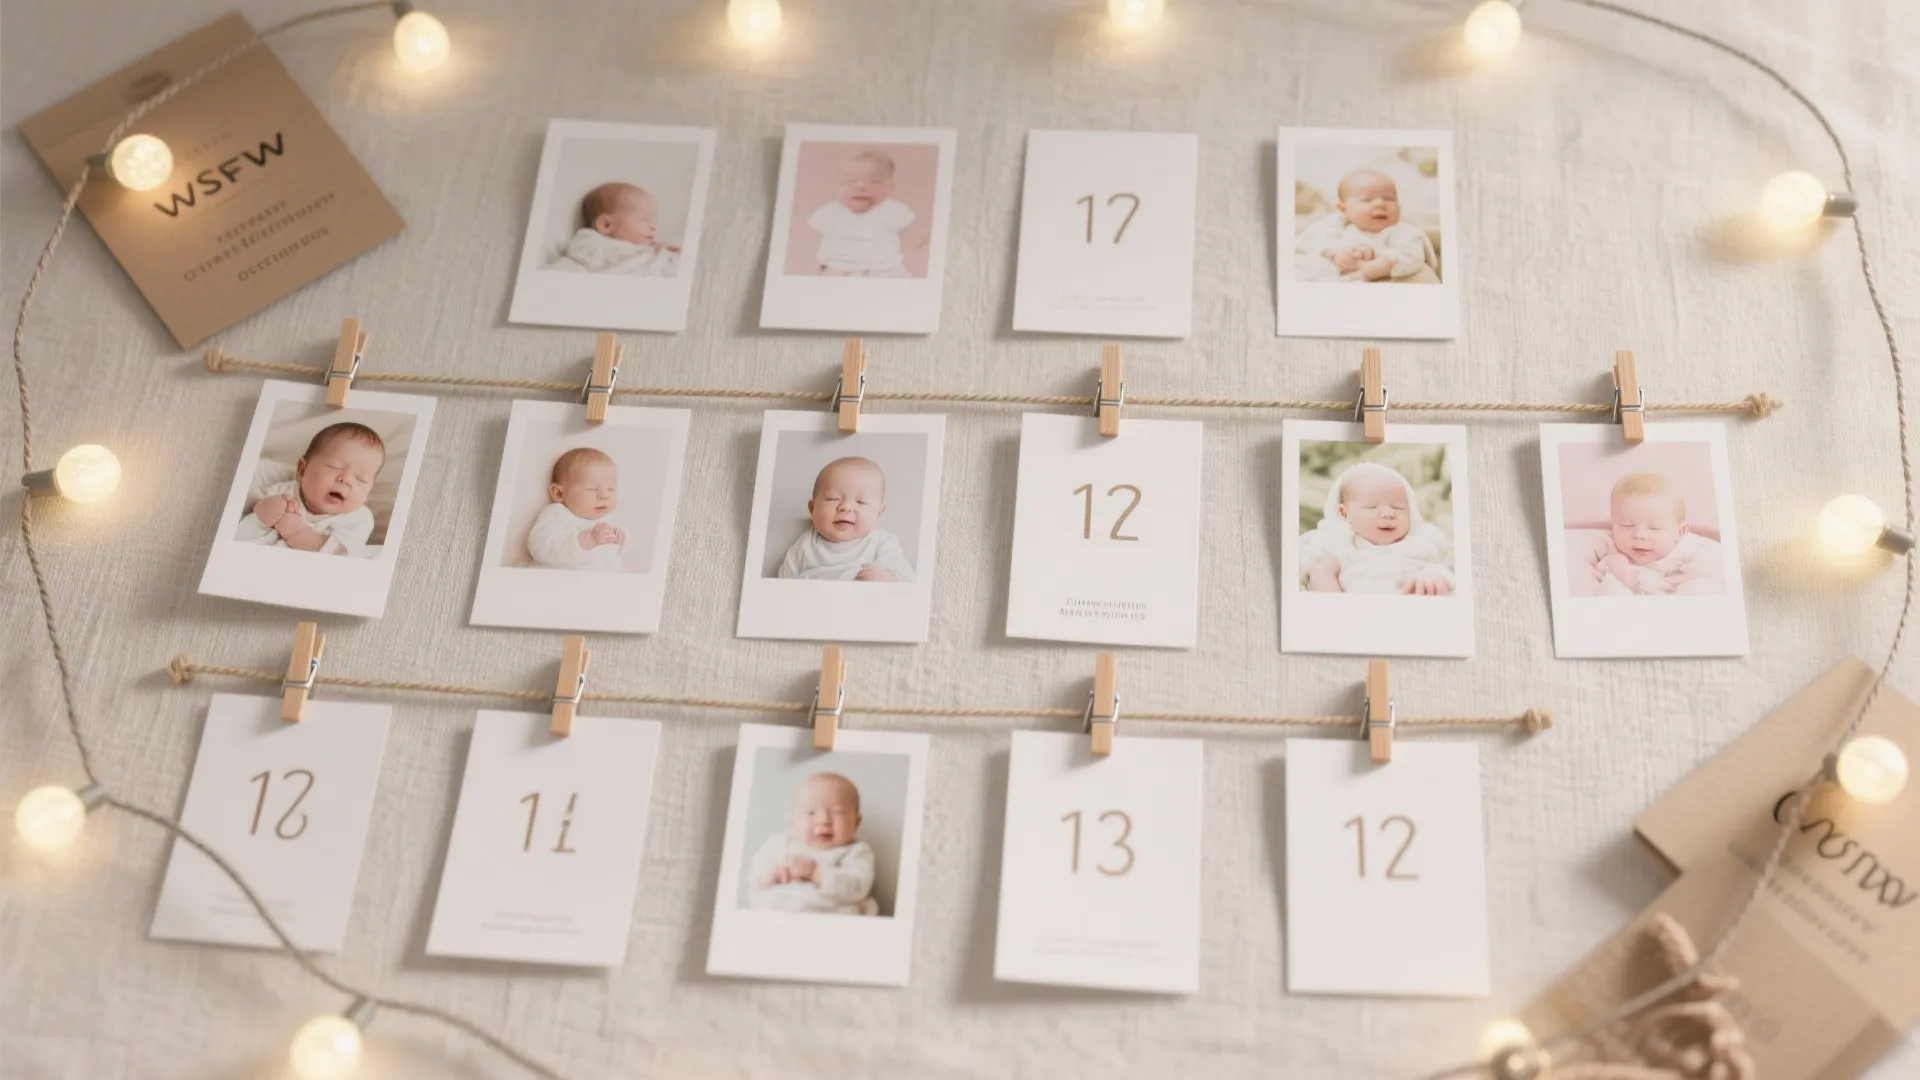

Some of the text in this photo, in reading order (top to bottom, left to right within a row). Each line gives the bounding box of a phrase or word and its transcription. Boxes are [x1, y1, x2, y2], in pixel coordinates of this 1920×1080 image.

[154, 132, 284, 218] WSFW
[1075, 192, 1140, 244] 17
[1073, 483, 1142, 541] 12
[1061, 809, 1135, 876] 13
[1343, 814, 1418, 880] 12
